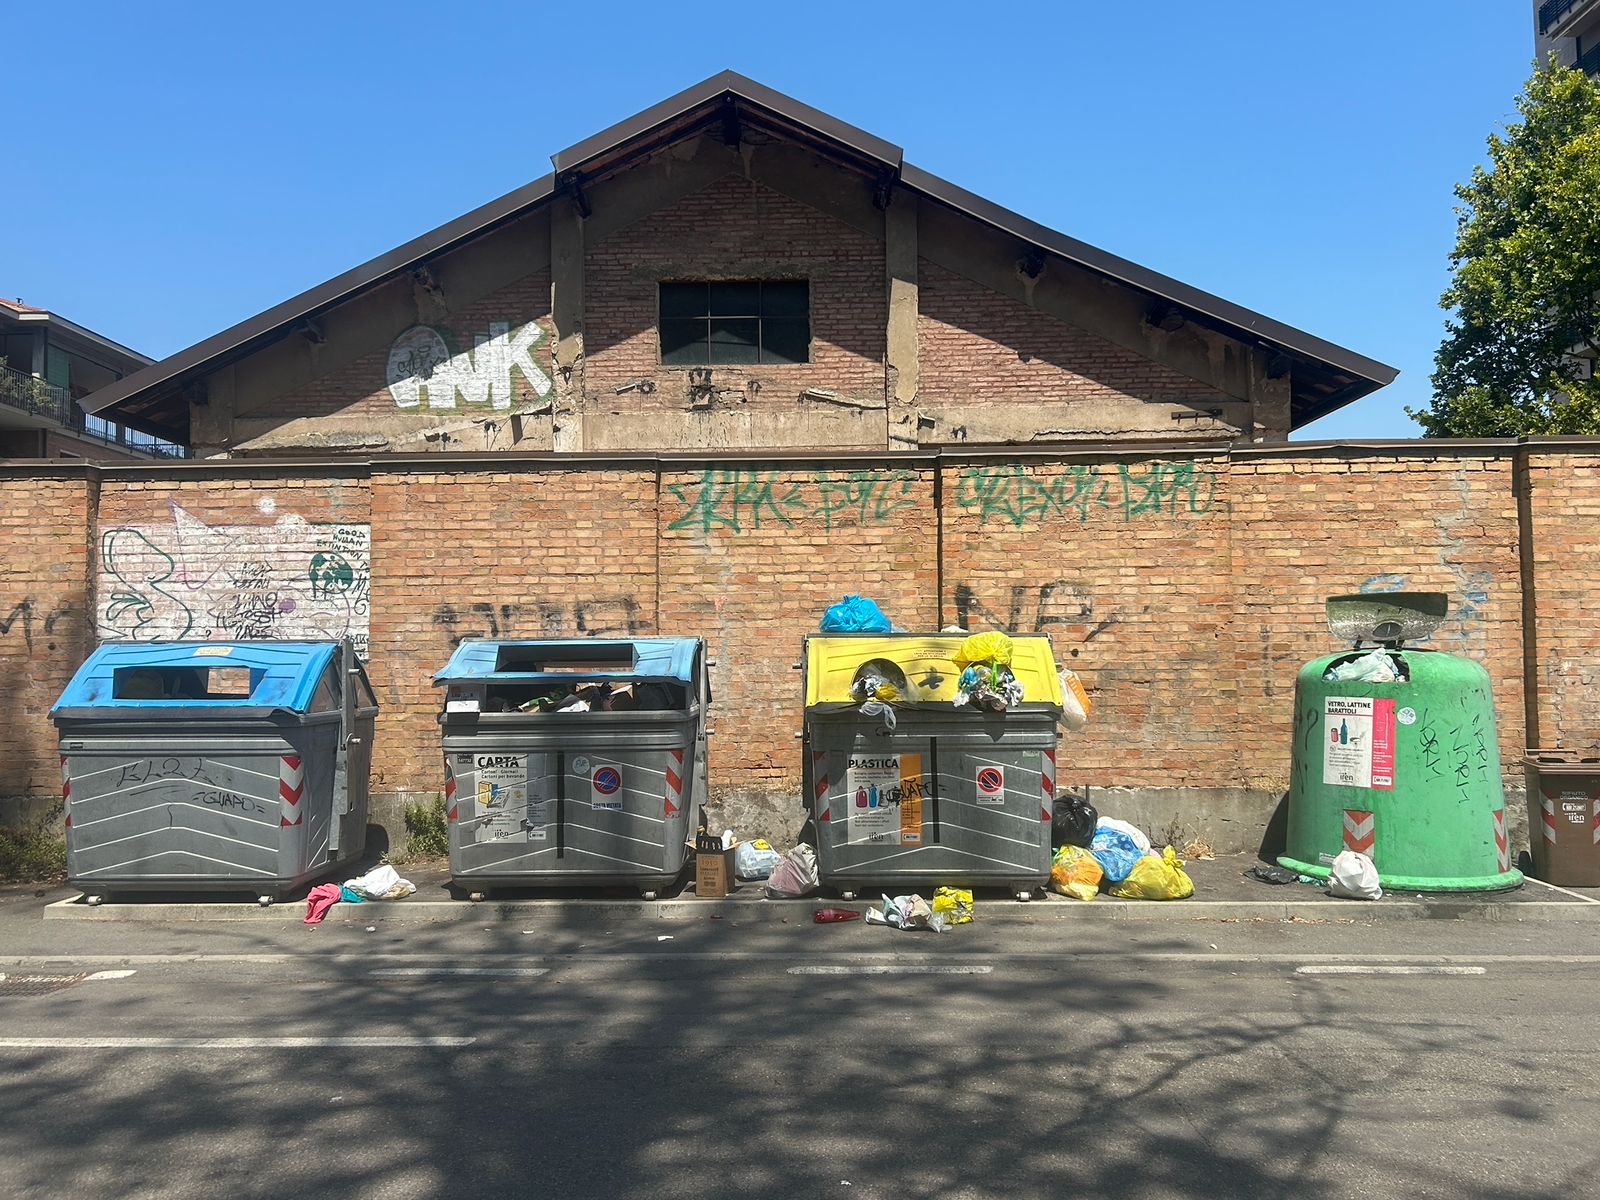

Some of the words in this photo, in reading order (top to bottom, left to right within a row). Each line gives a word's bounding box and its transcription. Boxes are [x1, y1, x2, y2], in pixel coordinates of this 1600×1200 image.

[338, 528, 366, 539] GOOD
[477, 756, 520, 768] CARTA
[848, 759, 899, 769] PLASTICA
